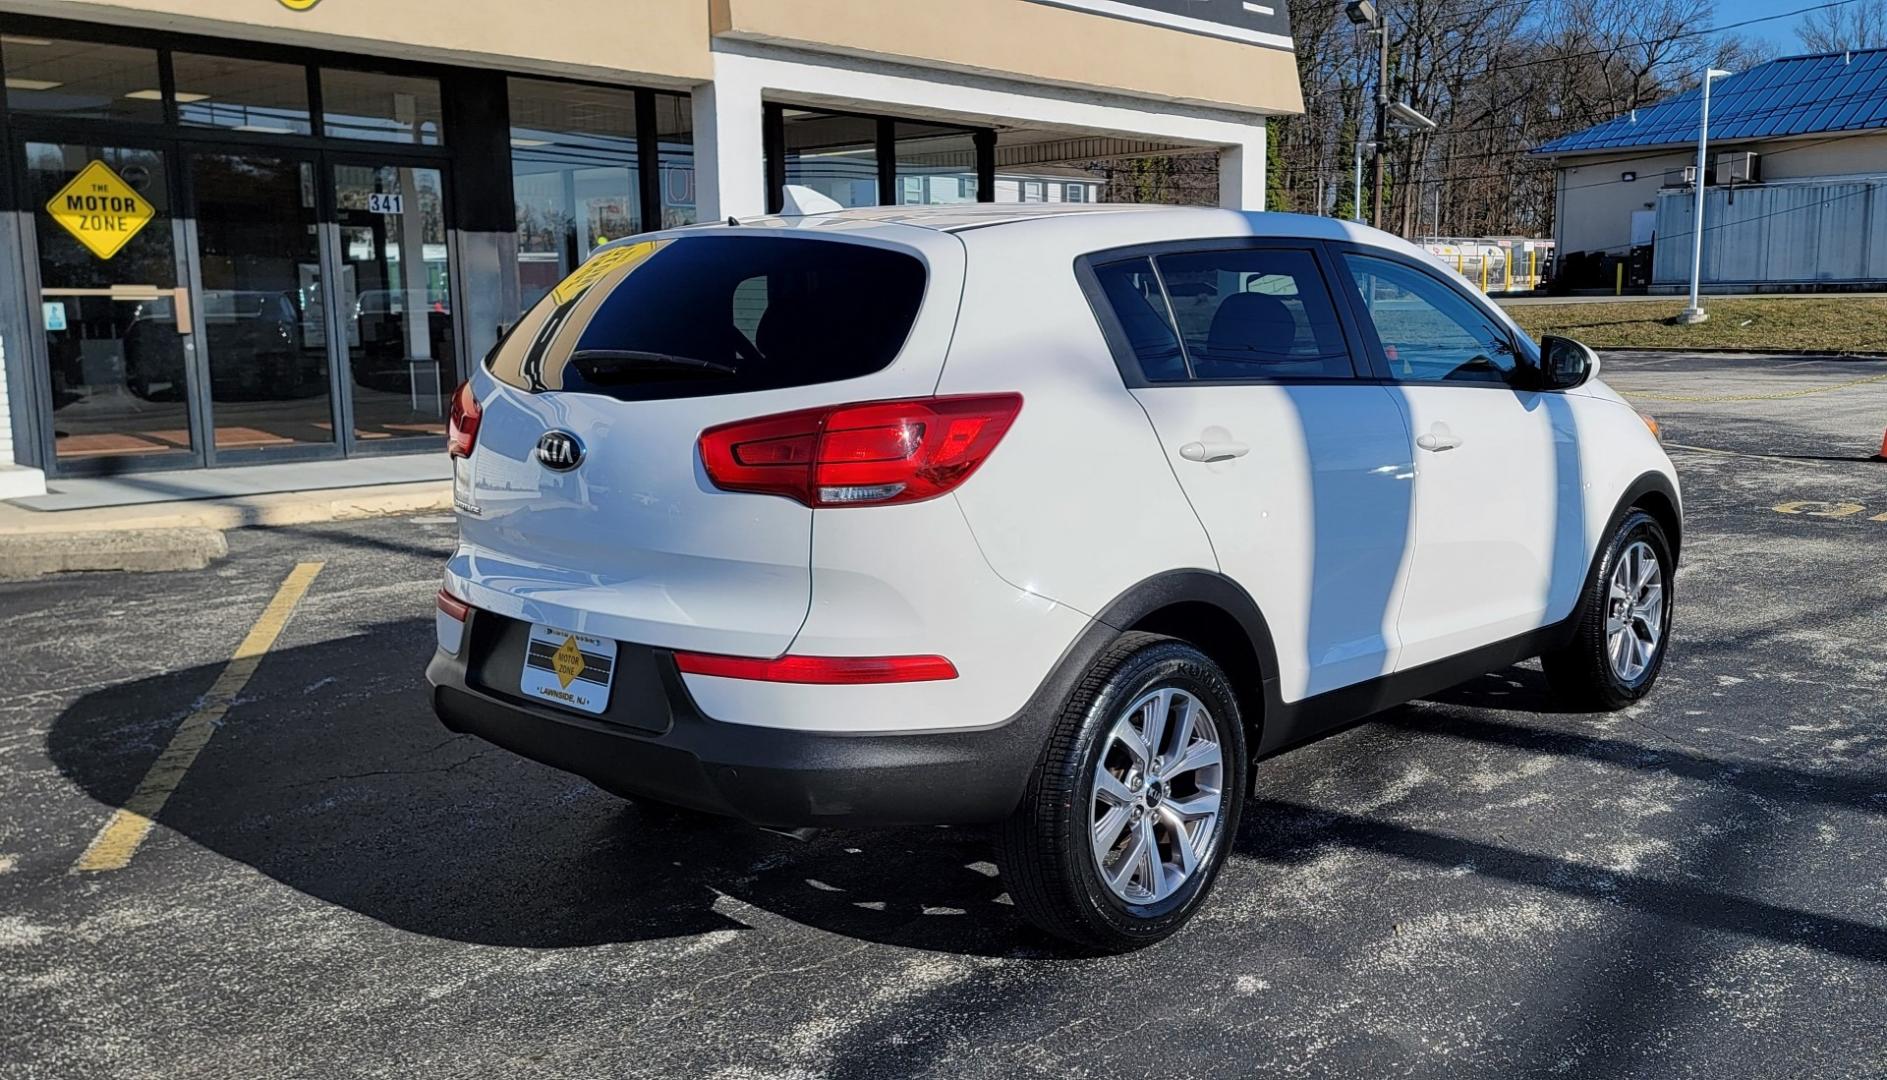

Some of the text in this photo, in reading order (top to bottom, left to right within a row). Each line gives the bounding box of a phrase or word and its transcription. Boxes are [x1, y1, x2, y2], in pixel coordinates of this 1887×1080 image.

[91, 183, 109, 193] THE
[66, 195, 136, 213] MOTOR
[371, 194, 400, 212] 341
[80, 214, 128, 232] ZONE
[540, 438, 574, 464] KIA
[558, 652, 579, 666] MOTOR
[559, 663, 575, 675] ZONE
[540, 686, 586, 705] LAWNSIDE, NJ
